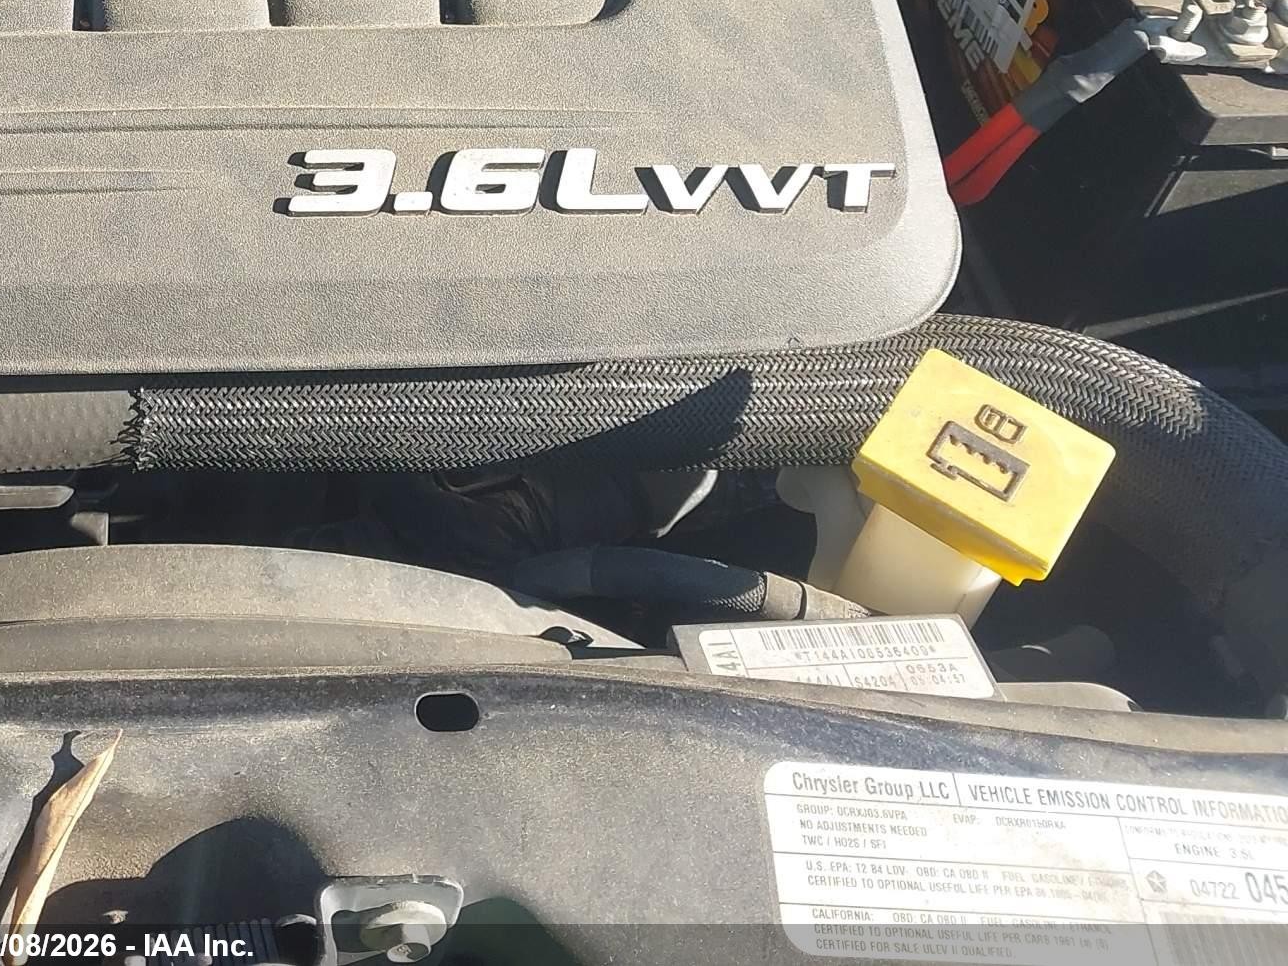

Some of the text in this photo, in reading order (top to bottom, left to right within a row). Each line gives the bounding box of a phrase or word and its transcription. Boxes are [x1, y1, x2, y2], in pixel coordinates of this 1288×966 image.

[274, 147, 896, 219] 3.6L VVT
[792, 772, 858, 794] Chrysler
[865, 777, 915, 800] Group
[920, 781, 950, 799] LLC
[968, 784, 1032, 804] VEHICLE
[1038, 789, 1111, 810] EMISSION
[1116, 793, 1188, 816] CONTROL
[797, 803, 833, 816] GROUP:
[800, 819, 927, 837] NO ADJUSTMENTS NEEDED
[802, 834, 824, 846] TWC
[1174, 842, 1221, 858] ENGINE
[806, 859, 826, 872] U.S.
[830, 861, 852, 874] EPA:
[808, 874, 857, 888] CERTIFIED
[862, 877, 874, 889] TO
[878, 879, 926, 892] OPTIONAL
[1189, 878, 1240, 900] 04722
[812, 907, 874, 922] CALIFORNIA:
[814, 923, 865, 937] CERTIFIED
[869, 925, 881, 937] TO
[885, 926, 934, 940] OPTIONAL
[816, 938, 866, 952] CERTIFIED
[870, 941, 890, 953] FOR
[894, 942, 920, 954] SALE
